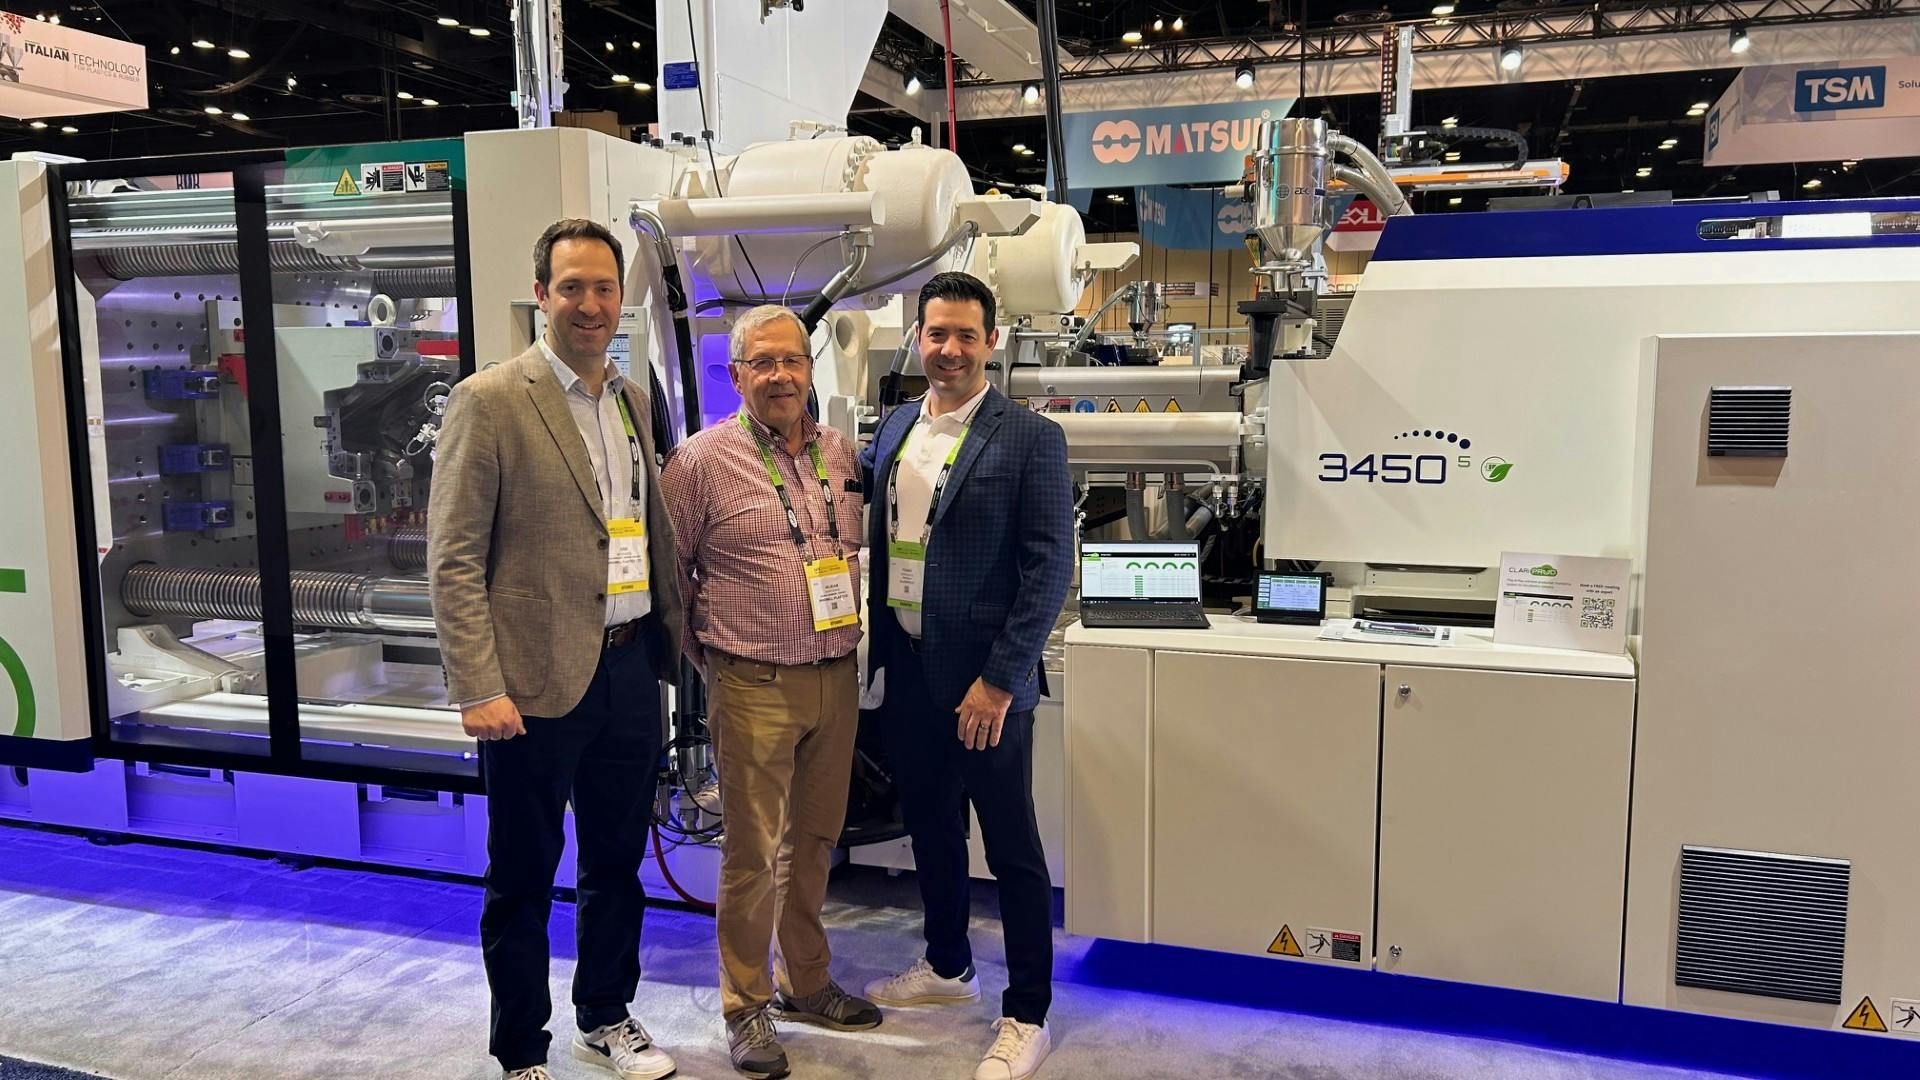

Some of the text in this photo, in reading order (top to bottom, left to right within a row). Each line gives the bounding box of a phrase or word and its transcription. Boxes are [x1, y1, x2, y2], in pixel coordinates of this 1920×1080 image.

[24, 42, 141, 76] ITALIAN TECHNOLOGY
[1804, 75, 1876, 104] TSM
[1145, 117, 1262, 156] MATSUI
[1318, 453, 1471, 484] 3450 5
